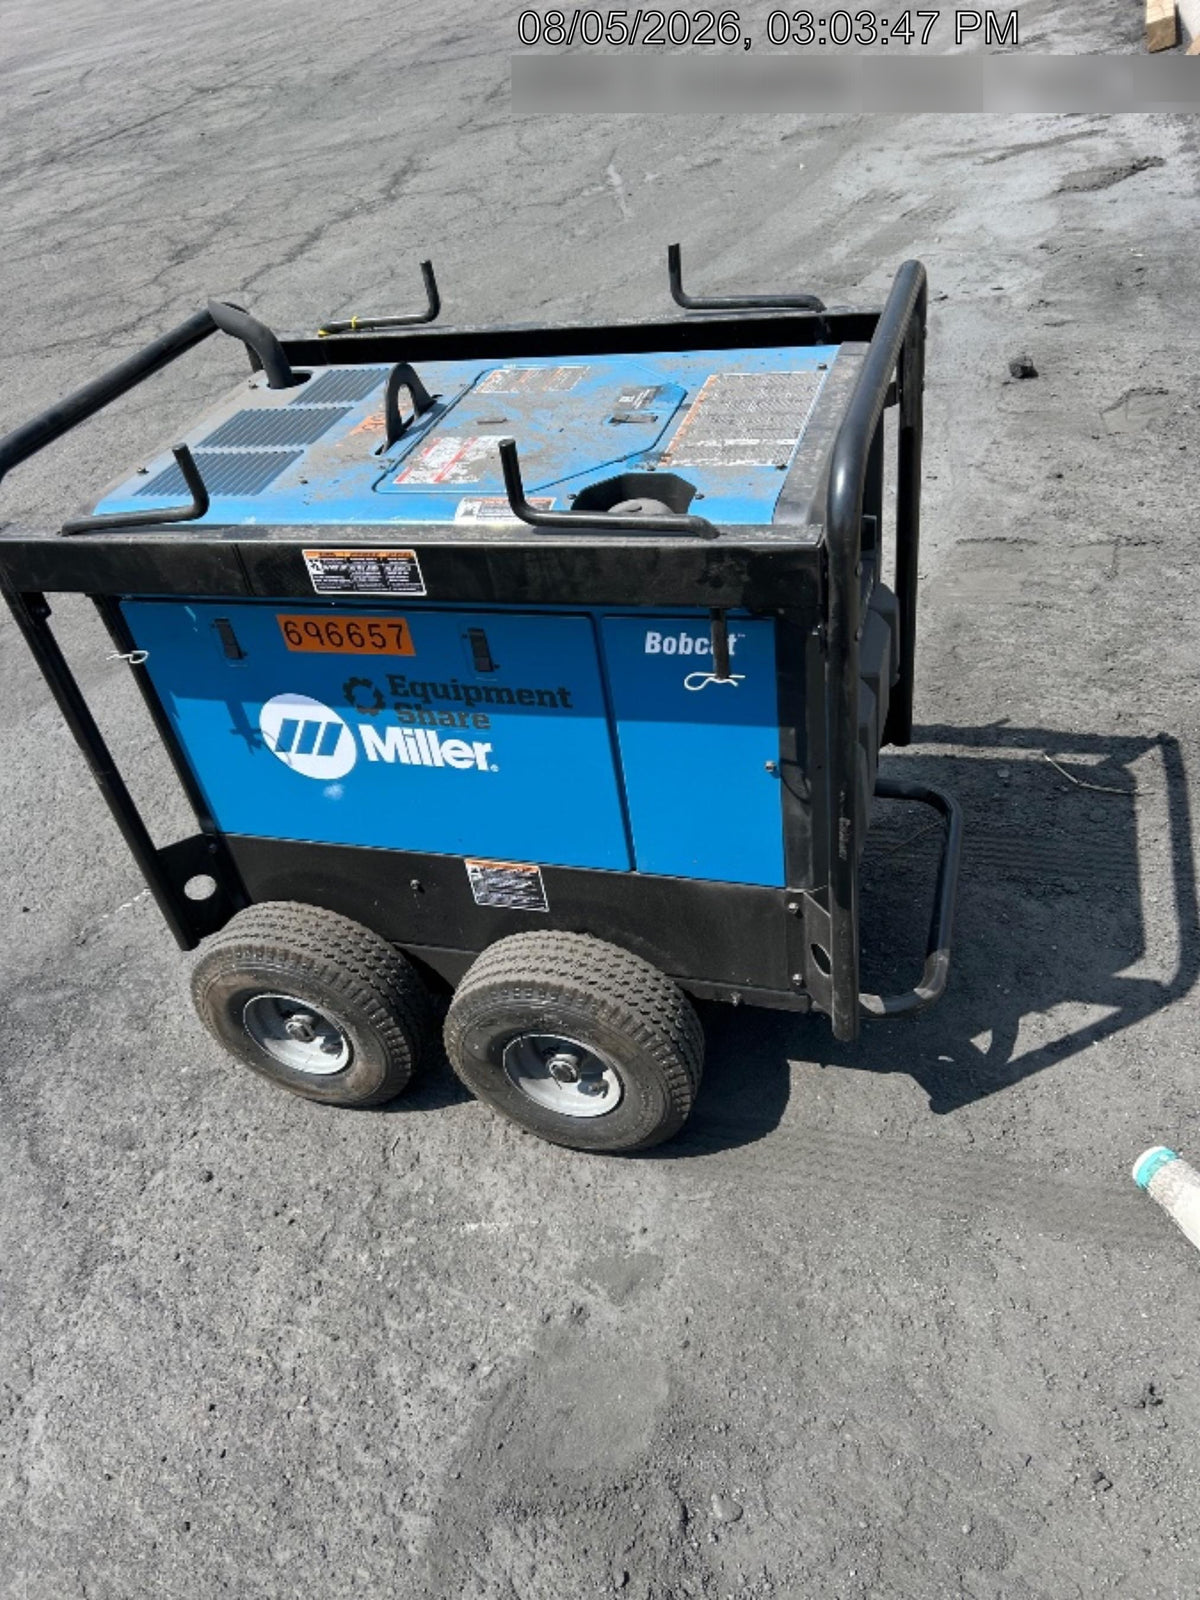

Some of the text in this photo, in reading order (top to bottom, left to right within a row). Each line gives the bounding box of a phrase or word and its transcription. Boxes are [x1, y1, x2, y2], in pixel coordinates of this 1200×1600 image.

[284, 620, 403, 649] 696657
[645, 632, 738, 655] Bobct
[386, 674, 573, 709] Equipment
[394, 702, 491, 729] Share
